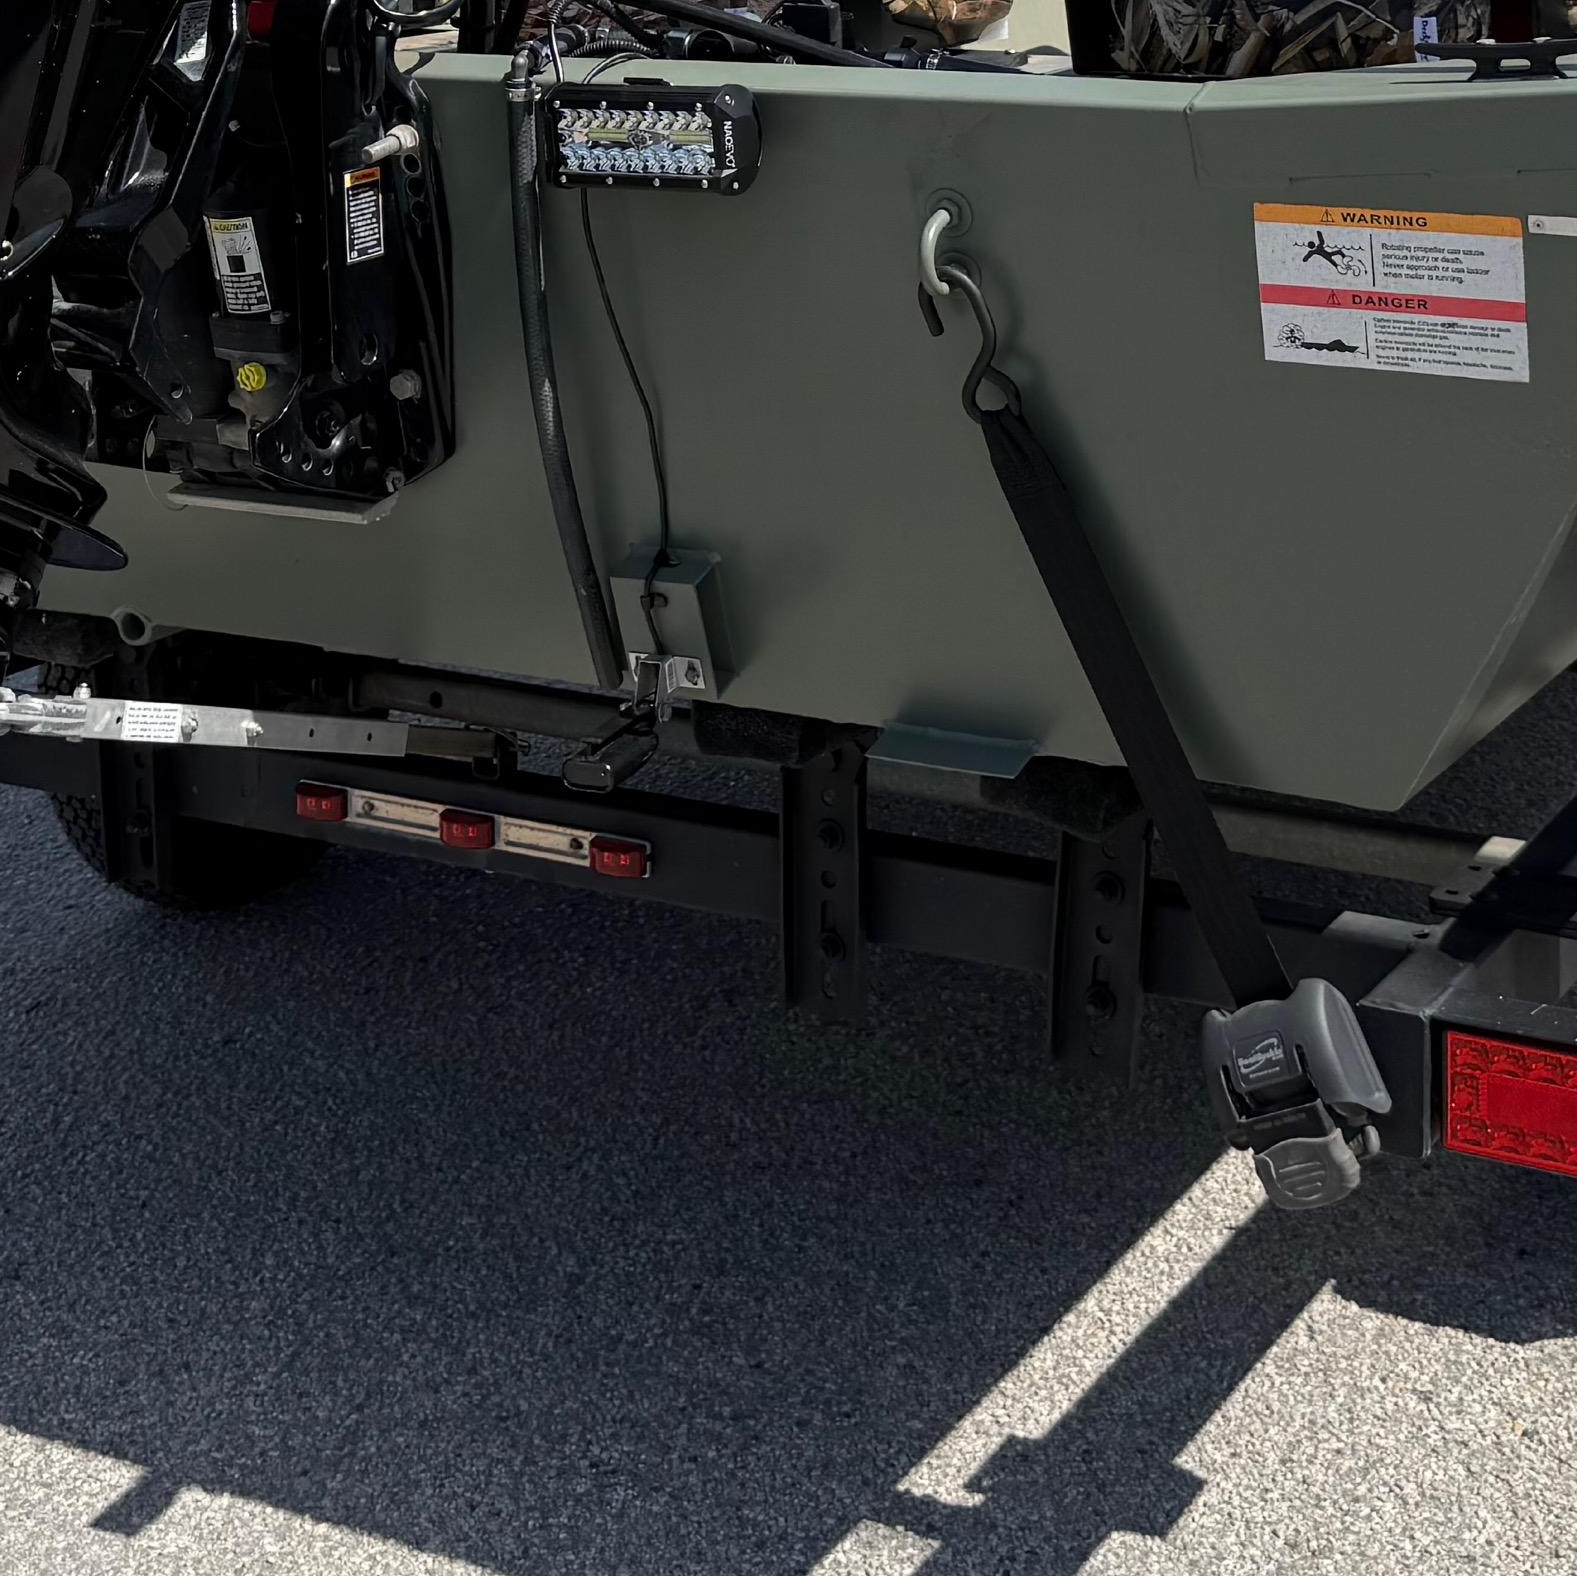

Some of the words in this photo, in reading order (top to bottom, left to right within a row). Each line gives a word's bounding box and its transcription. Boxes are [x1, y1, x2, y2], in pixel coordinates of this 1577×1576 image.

[1341, 212, 1428, 228] WARNING
[1409, 254, 1430, 263] injury
[1351, 294, 1429, 310] DANGER
